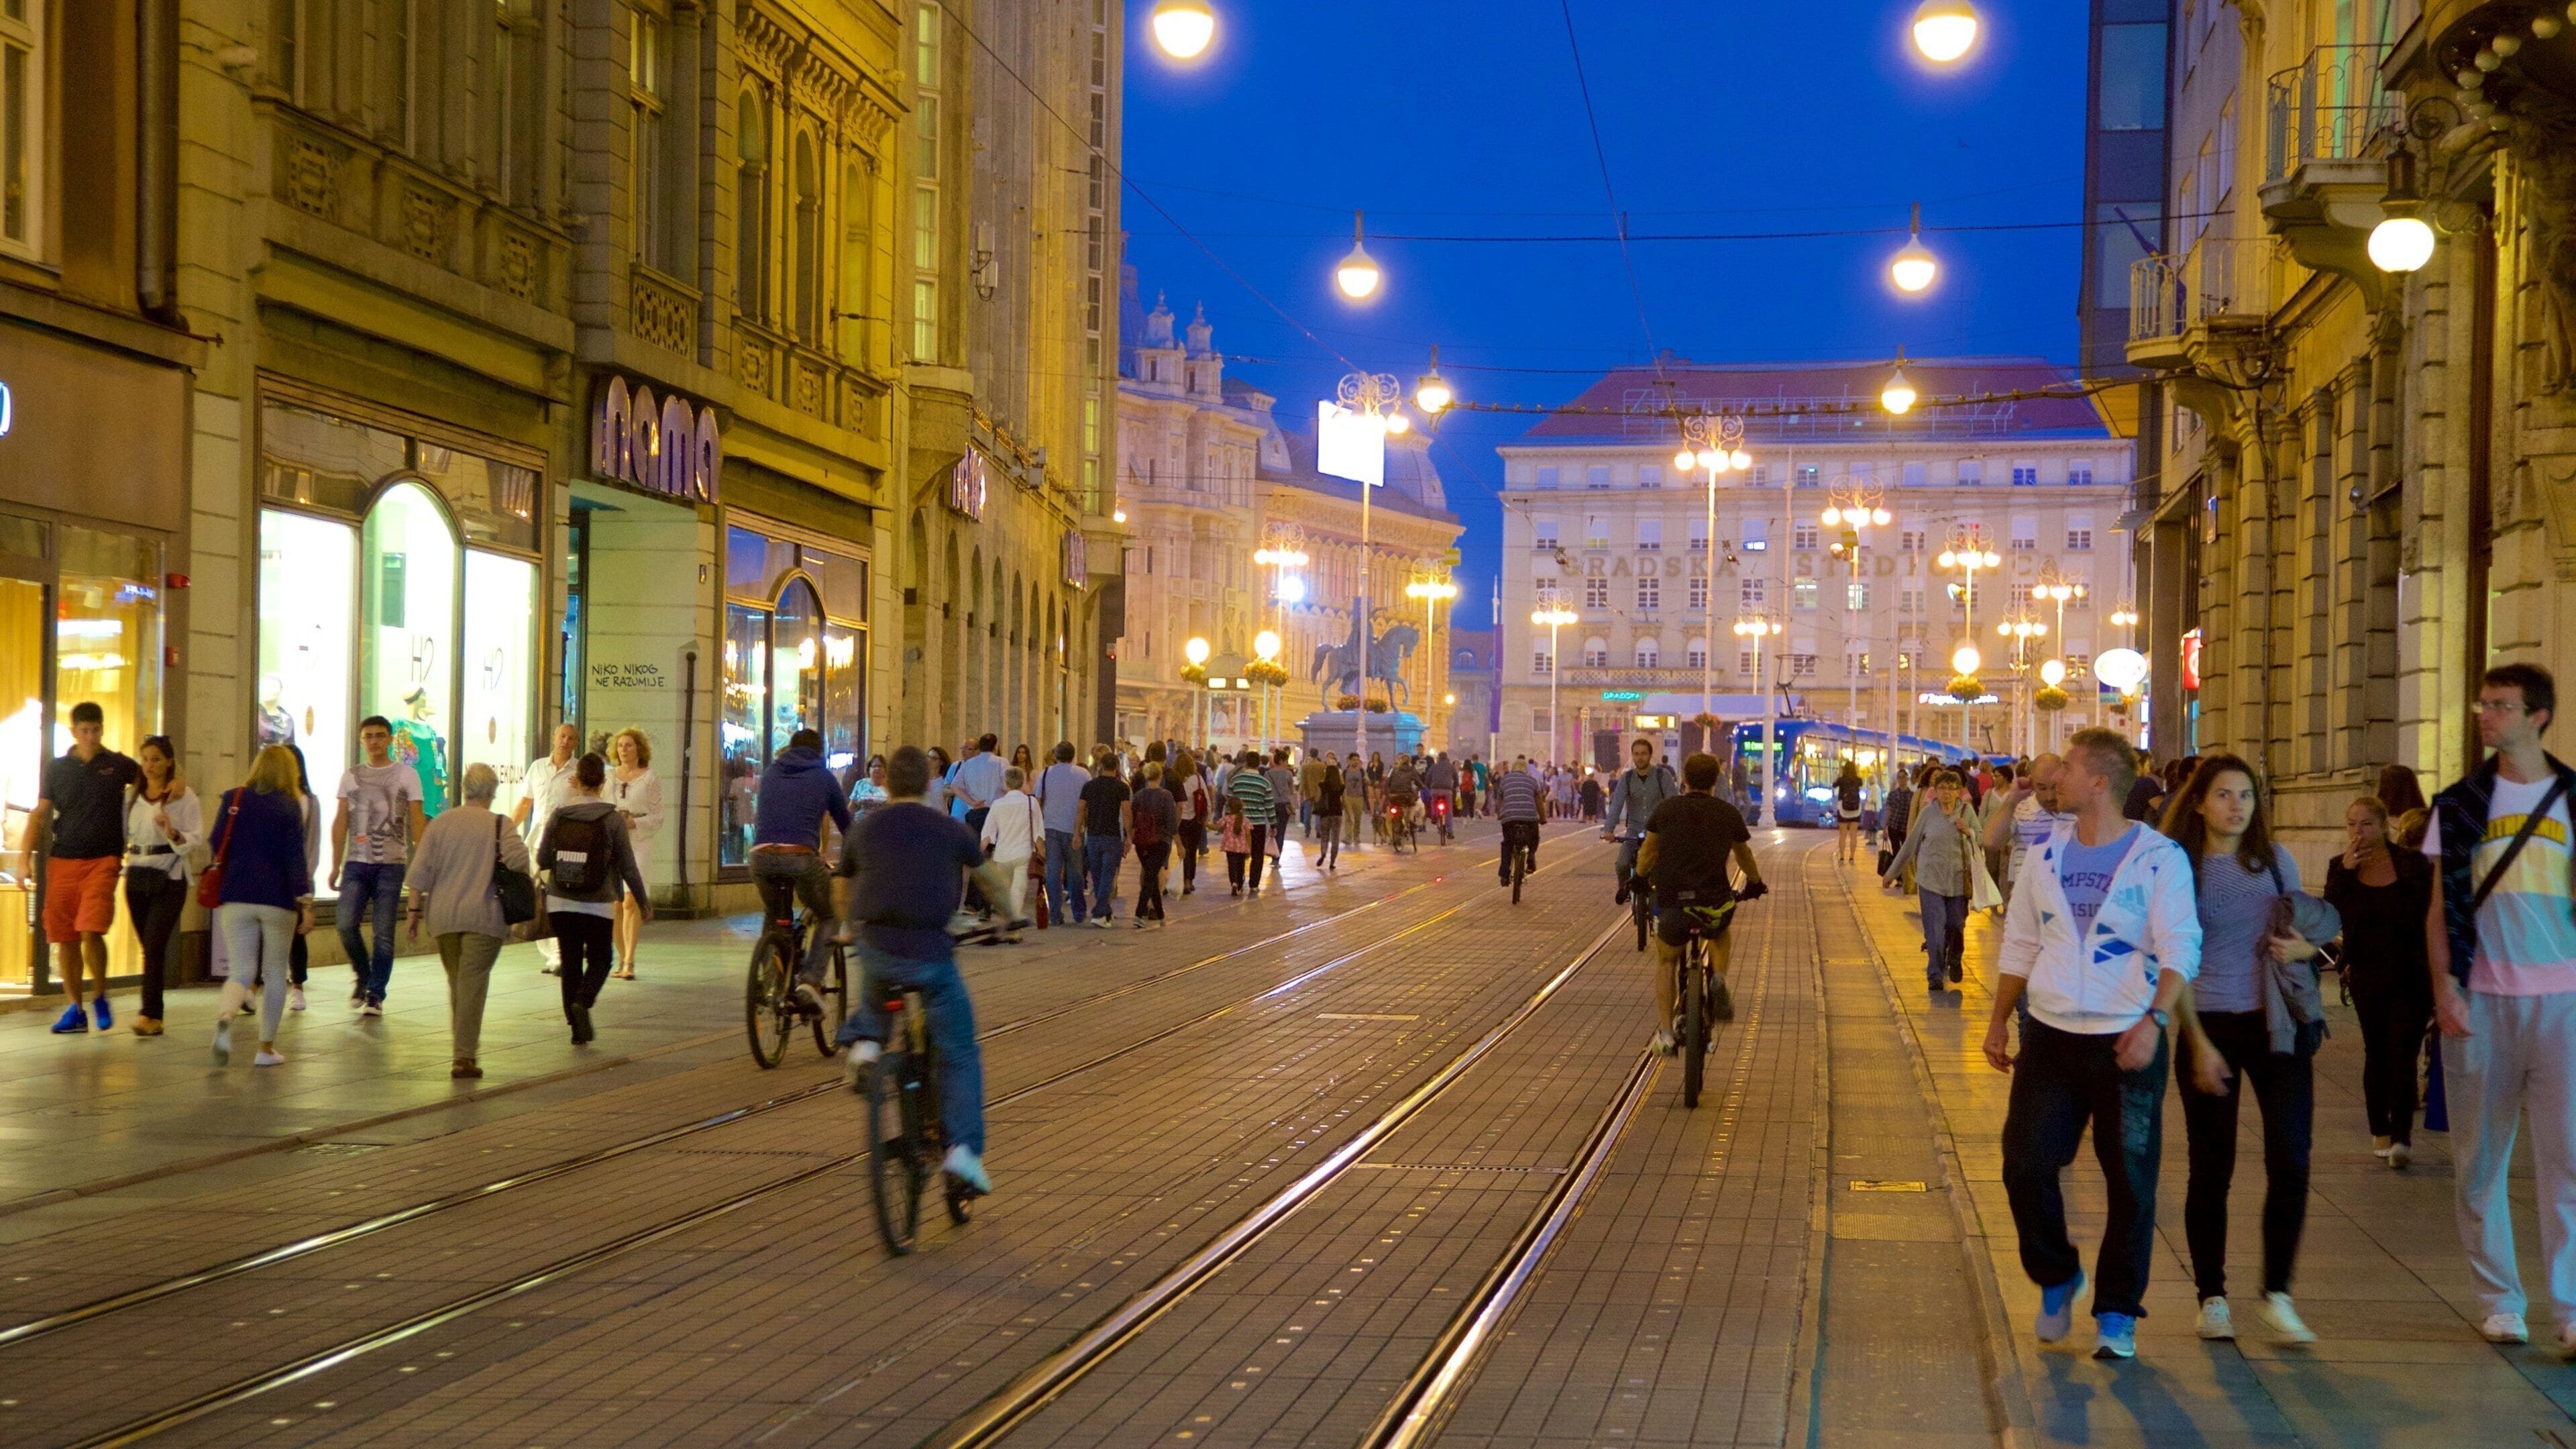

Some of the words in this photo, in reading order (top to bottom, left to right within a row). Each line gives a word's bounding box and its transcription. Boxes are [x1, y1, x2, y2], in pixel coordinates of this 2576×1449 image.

[1562, 555, 1737, 577] GRADSKA
[592, 664, 619, 676] NIKO
[624, 664, 659, 676] NIKOG
[596, 676, 610, 687] NE
[613, 676, 665, 687] RAZUMIJE
[556, 850, 588, 863] PUMA
